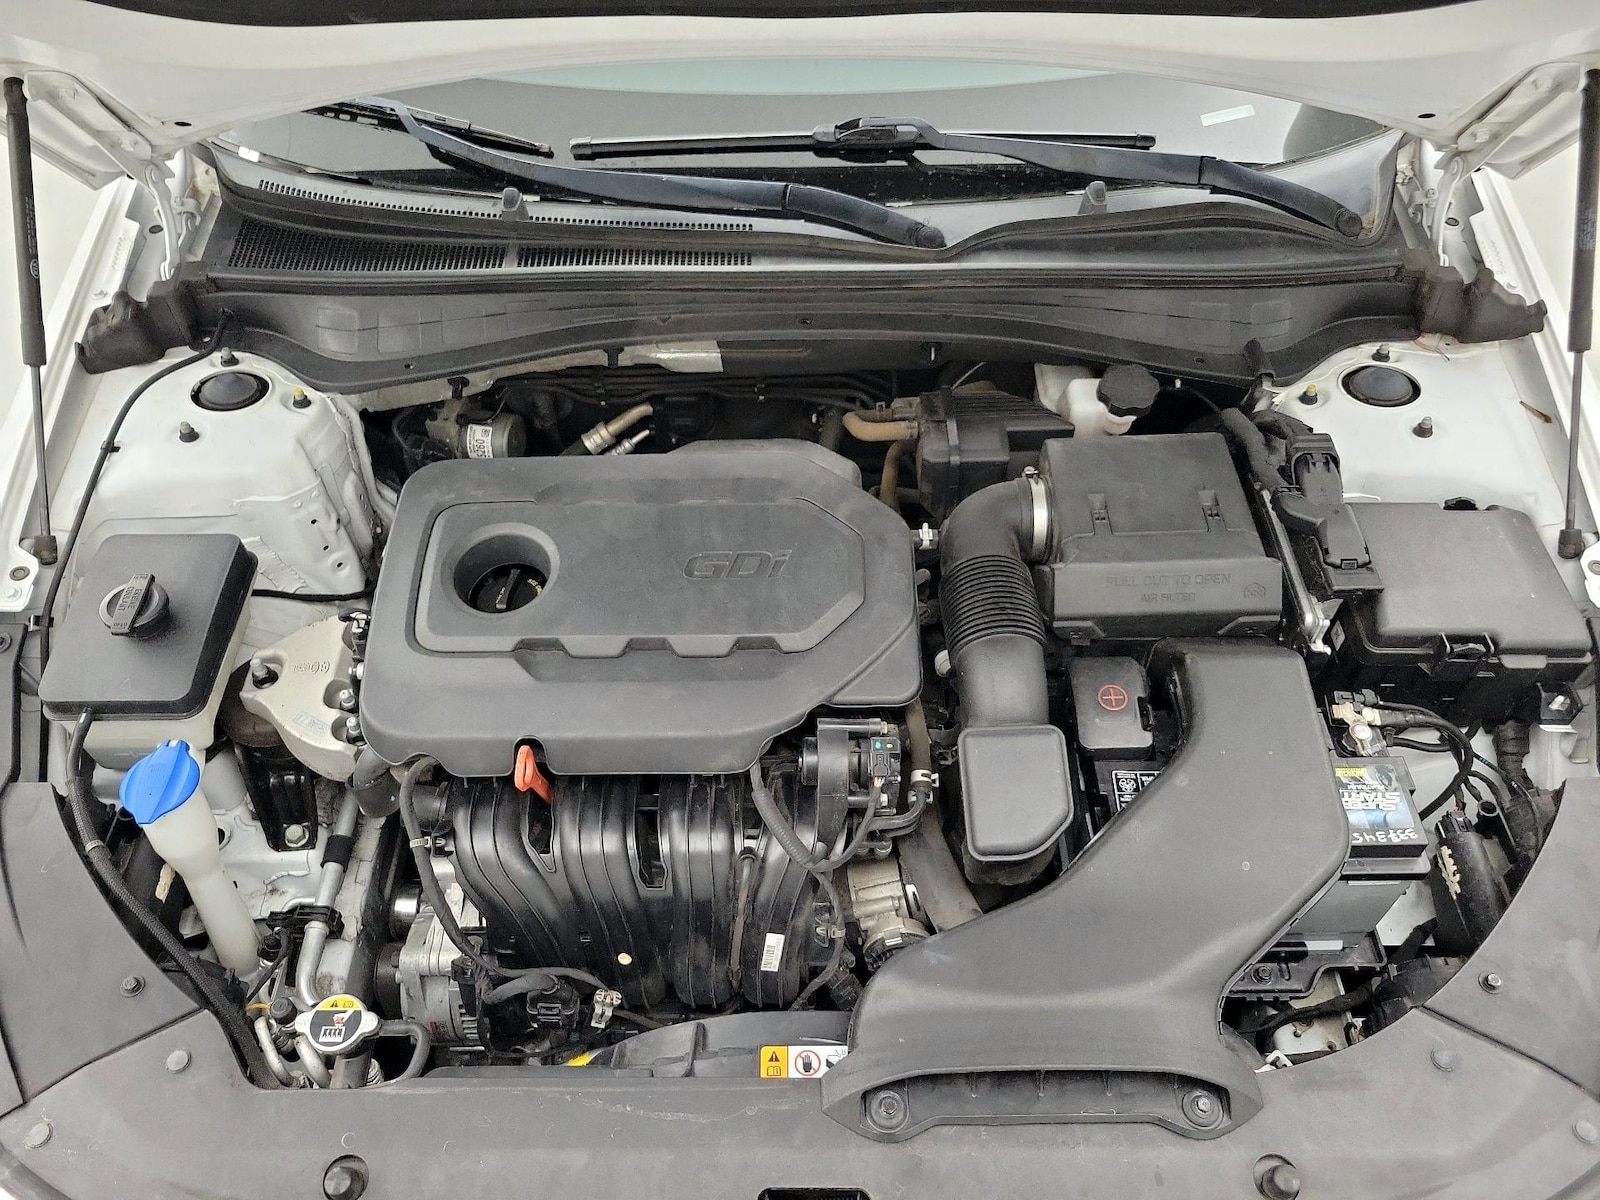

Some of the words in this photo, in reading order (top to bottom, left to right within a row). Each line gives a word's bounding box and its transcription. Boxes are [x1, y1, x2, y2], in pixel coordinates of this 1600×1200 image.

[682, 549, 793, 579] GDi
[1173, 573, 1191, 586] TO
[1194, 572, 1232, 585] OPEN
